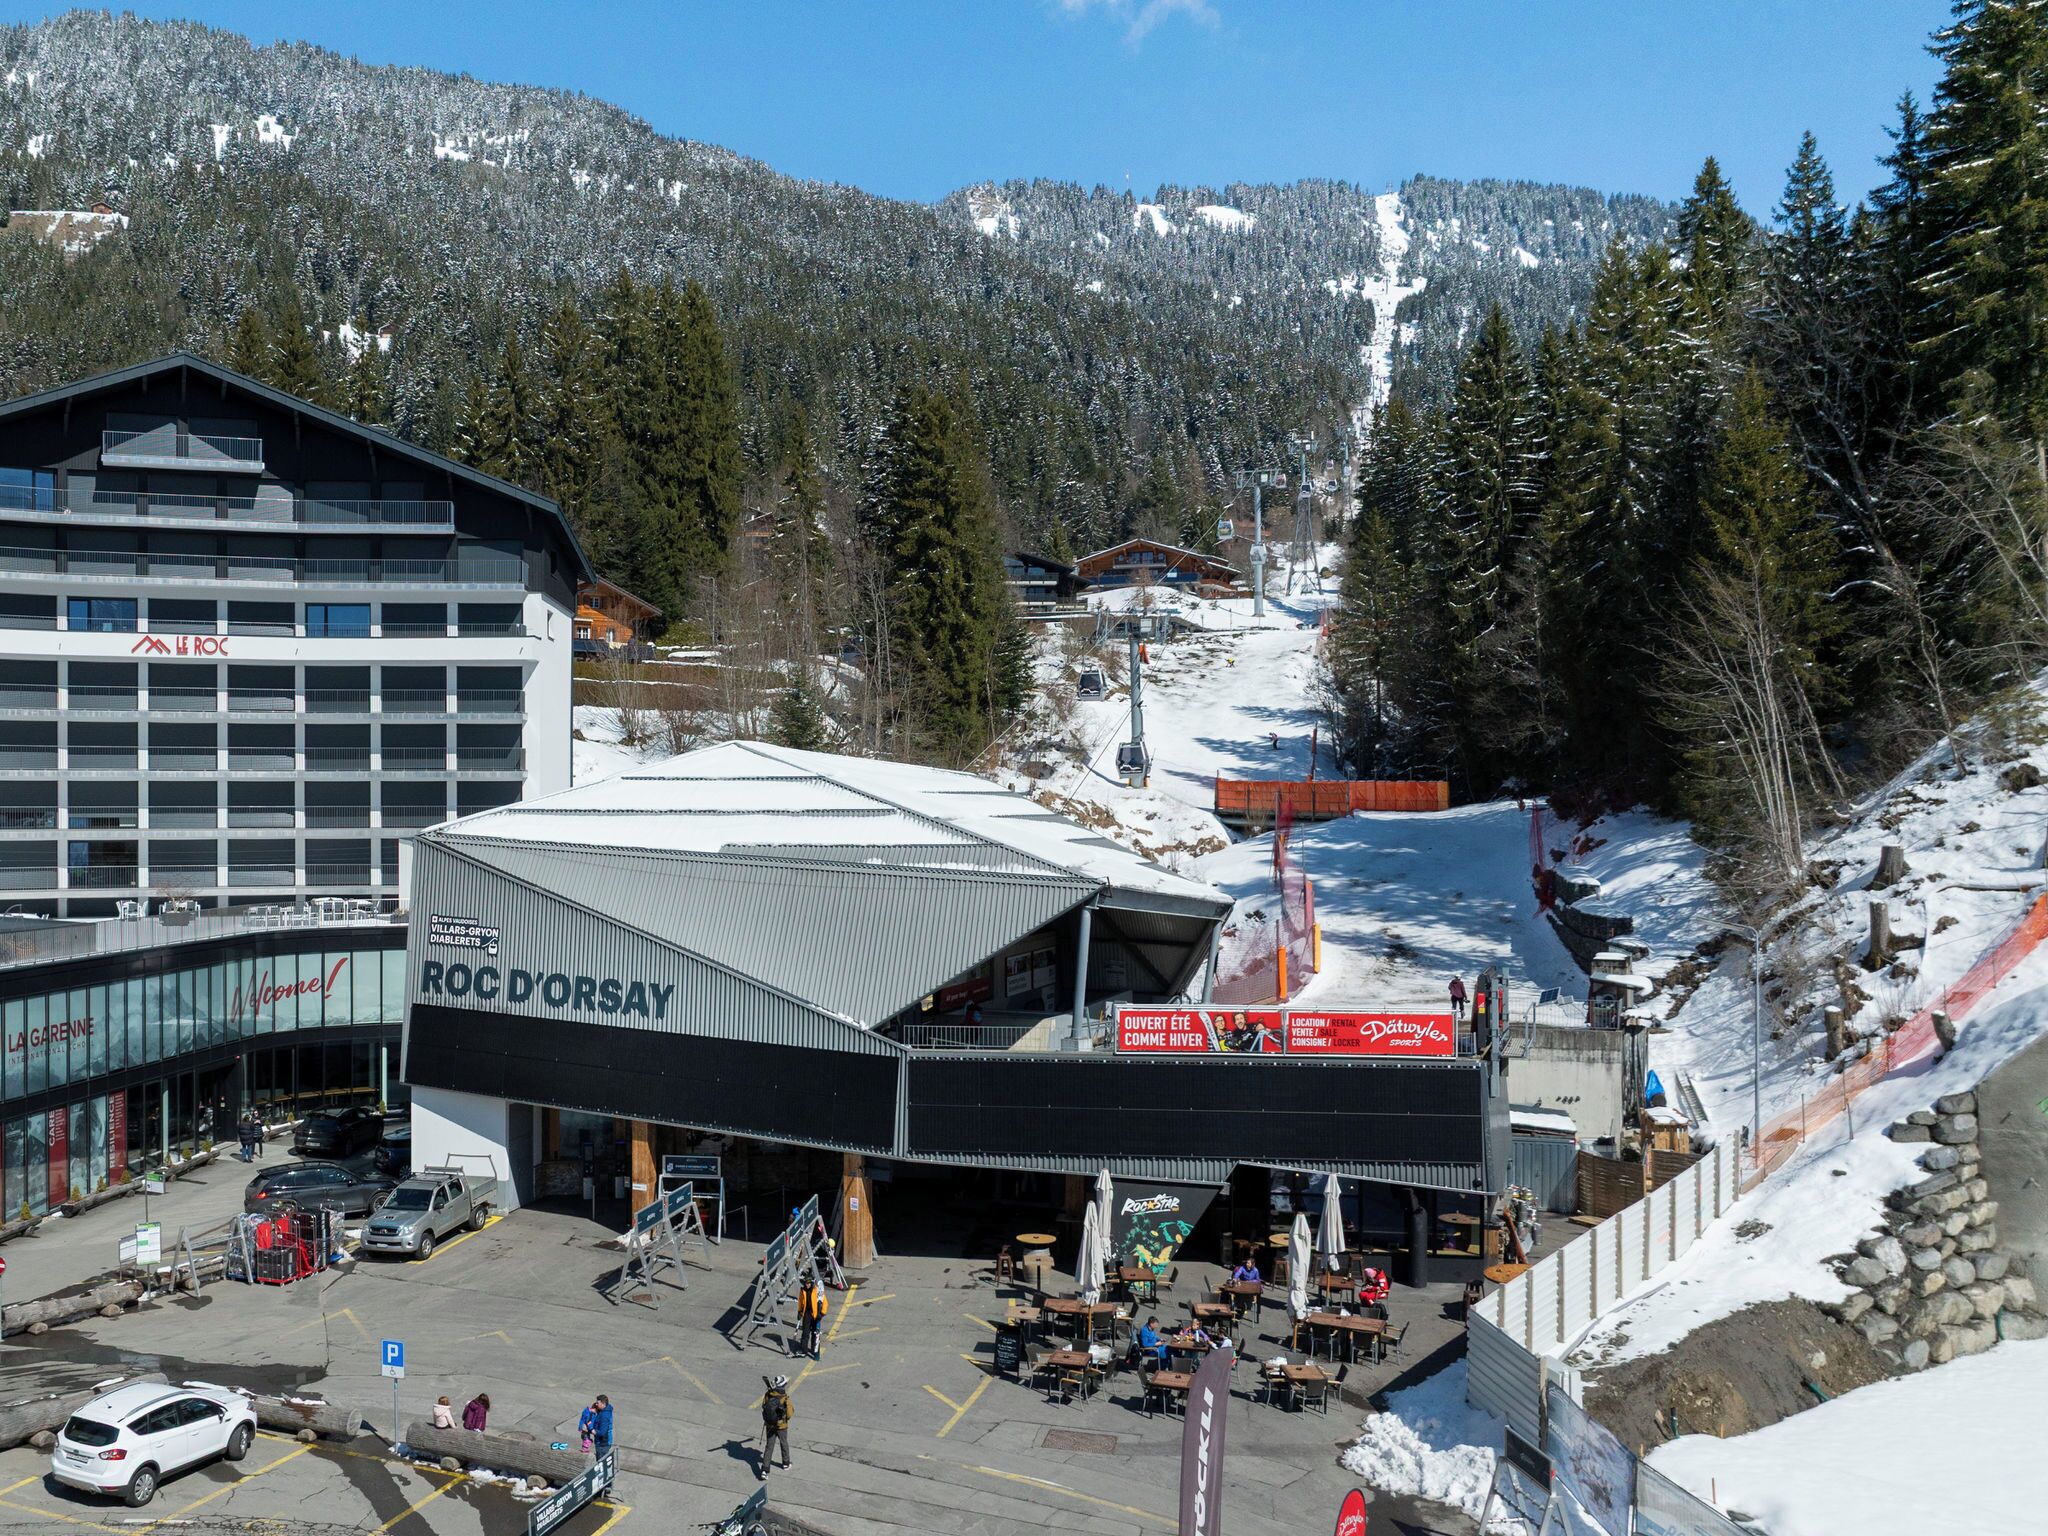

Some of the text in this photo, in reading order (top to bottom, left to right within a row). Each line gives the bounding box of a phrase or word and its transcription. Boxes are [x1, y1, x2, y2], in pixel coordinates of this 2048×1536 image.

[176, 635, 228, 656] LE ROC
[431, 924, 499, 938] VILLARS-GRYON
[453, 917, 478, 925] VAUDOISES
[430, 934, 481, 946] DIABLERETS
[231, 957, 348, 1023] Welcome!
[422, 960, 675, 1020] ROC D'ORSAY
[1124, 1016, 1168, 1030] OUVERT
[1171, 1013, 1191, 1030] ÉTÉ
[1291, 1018, 1325, 1027] LOCATION
[1331, 1019, 1357, 1027] RENTAL
[1360, 1019, 1449, 1043] Dätwyler
[8, 1017, 94, 1053] LA GARENNE
[1124, 1032, 1203, 1047] COMME HIVER
[1291, 1027, 1314, 1037] VENTE
[1320, 1029, 1338, 1037] SALE
[1291, 1037, 1327, 1047] CONSIGNE
[1332, 1038, 1361, 1047] LOCKER
[8, 1039, 95, 1065] INTENATONAL CHOL
[1389, 1039, 1422, 1047] SPORTS
[48, 1110, 56, 1147] CARE
[108, 1095, 116, 1168] RESILIENCE
[387, 1343, 399, 1363] P
[536, 1491, 573, 1522] VILLARS-GRYON
